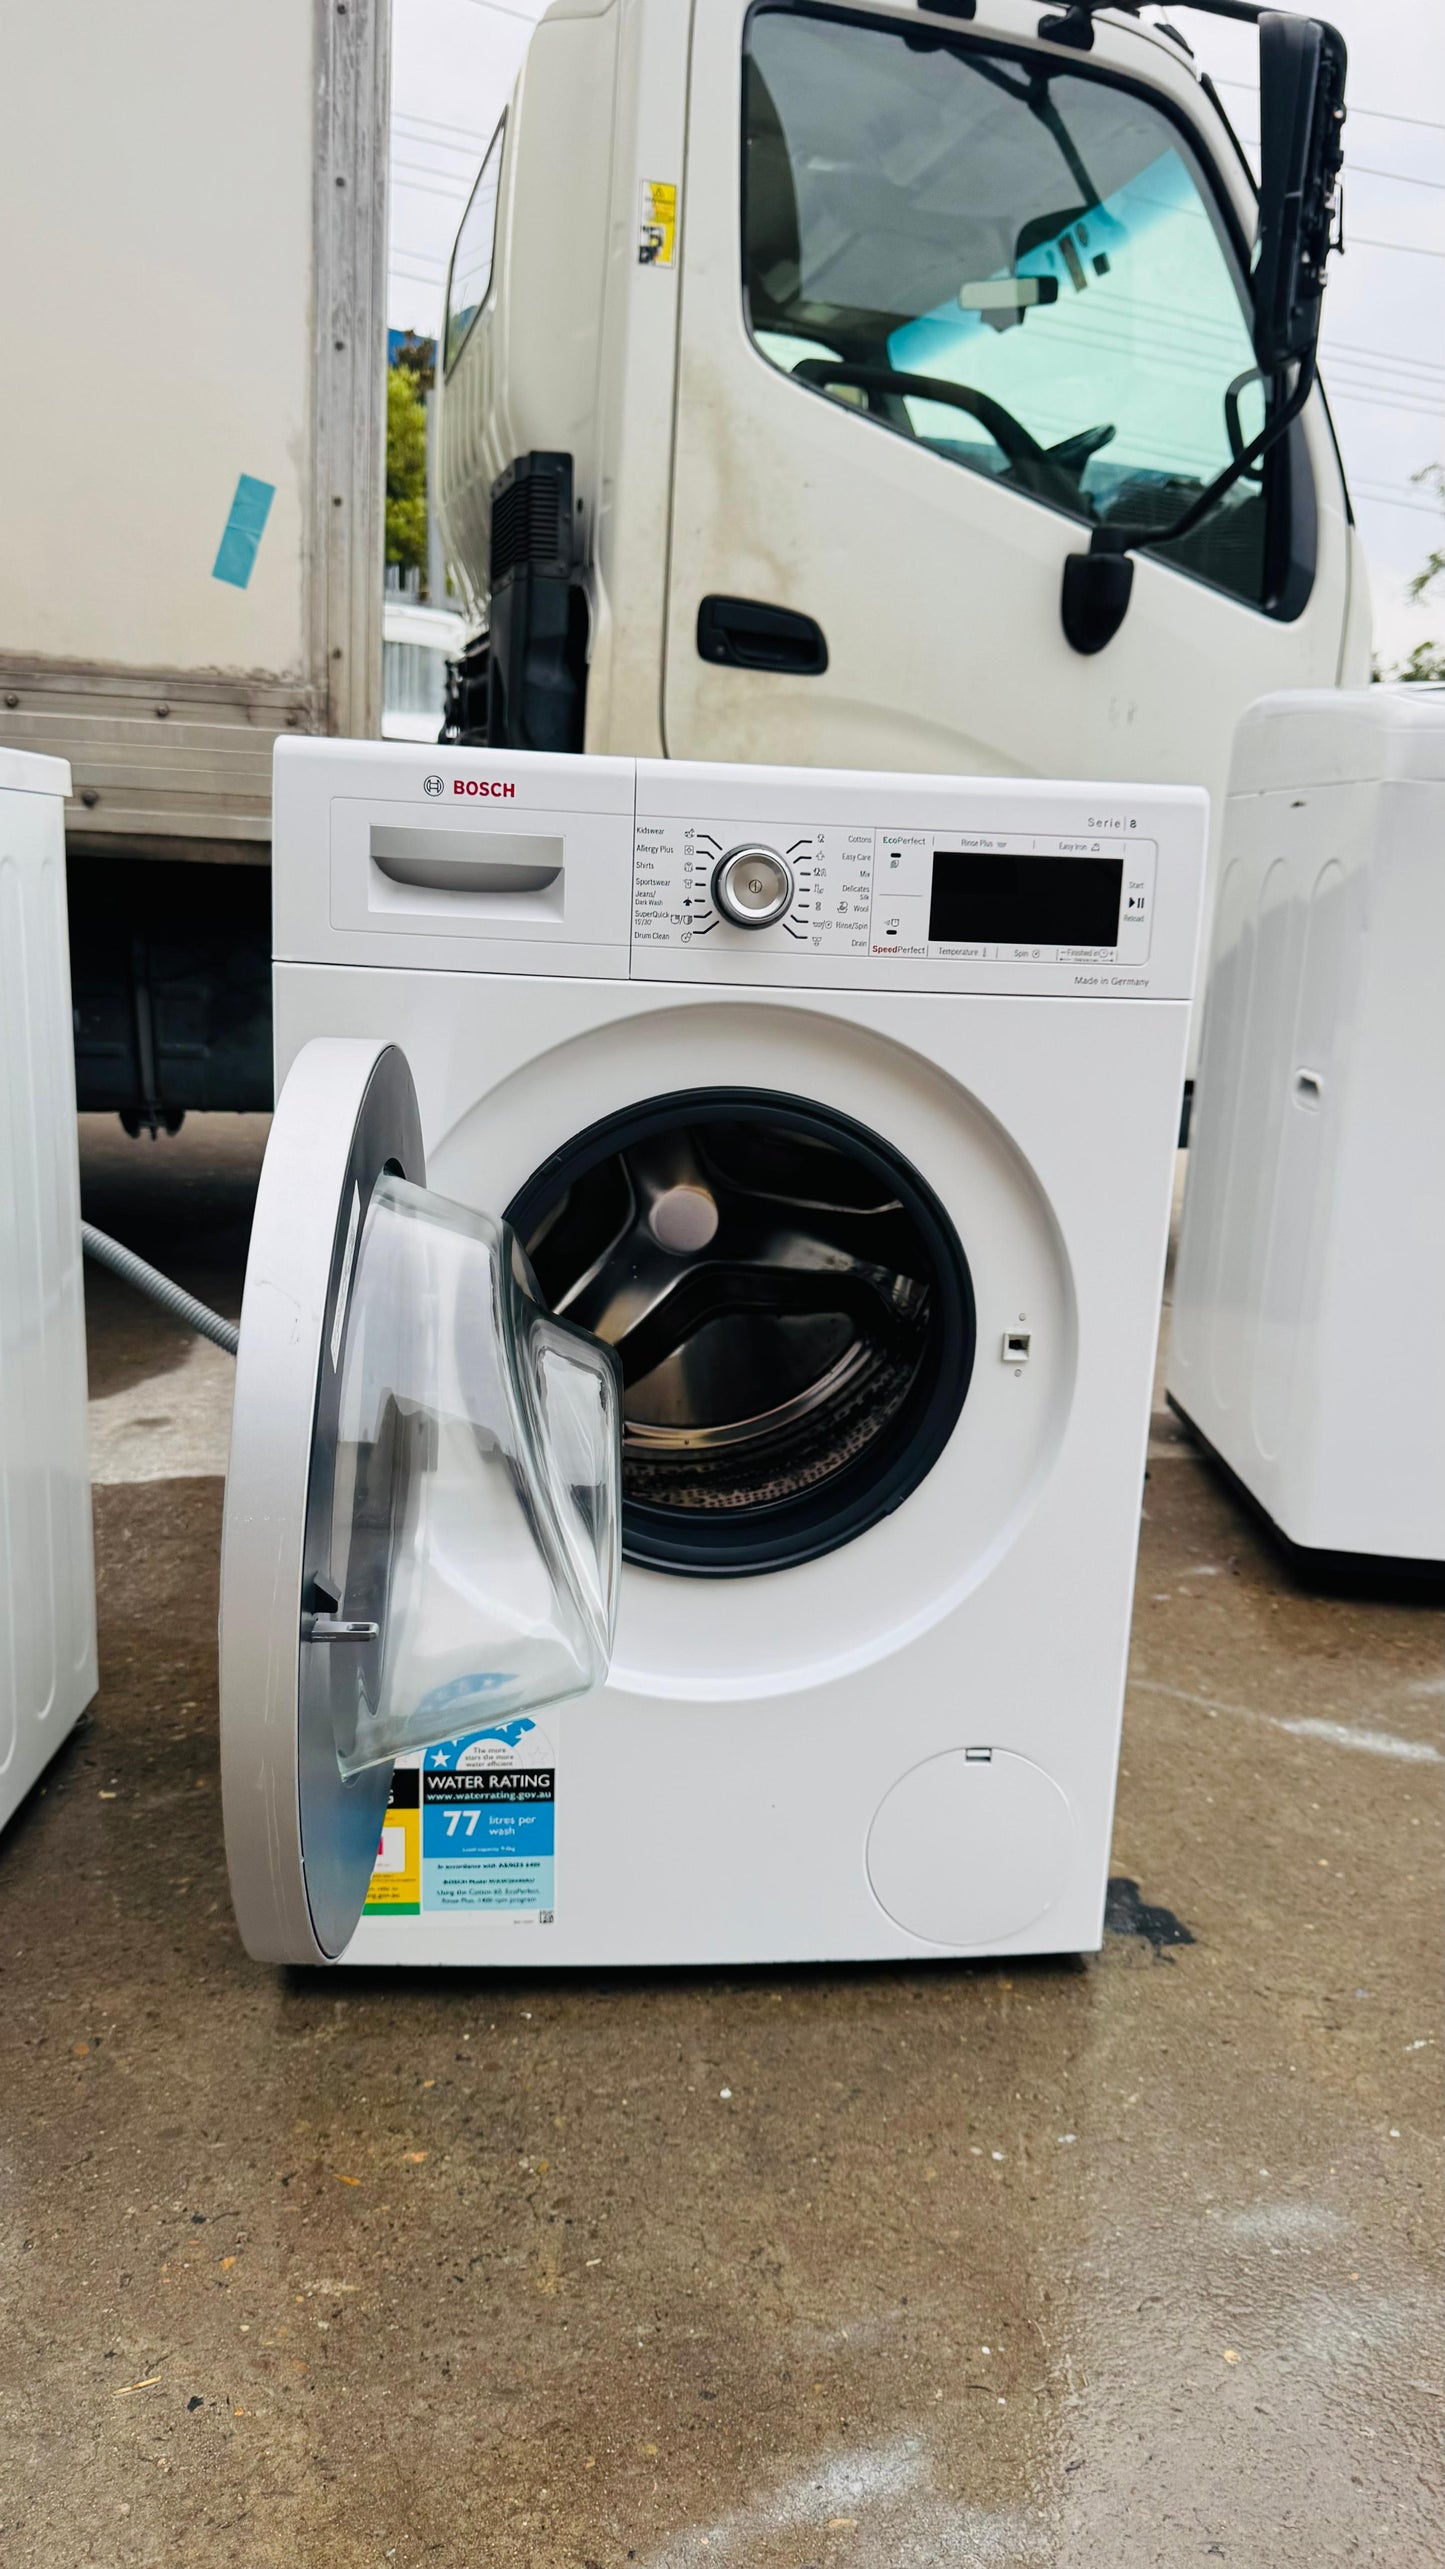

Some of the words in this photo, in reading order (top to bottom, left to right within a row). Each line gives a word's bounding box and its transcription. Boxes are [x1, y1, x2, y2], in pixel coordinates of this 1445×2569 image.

[453, 780, 515, 798] BOSCH
[1088, 817, 1121, 829] Serie
[1129, 819, 1138, 829] 8
[636, 826, 665, 835] Kidswear
[848, 835, 872, 844] Cottons
[882, 836, 926, 846] EcoPerfect
[979, 839, 994, 848] Plus
[636, 845, 659, 855] Allergy
[660, 845, 674, 854] Plus
[842, 852, 856, 862] Easy
[857, 853, 871, 861] Care
[635, 861, 655, 870] Shirts
[860, 870, 871, 878] Mix
[635, 877, 671, 887] Sportswear
[842, 884, 870, 893] Delicates
[635, 890, 657, 899] Jeans/
[635, 899, 649, 907] Dark
[853, 904, 869, 913] Wool
[635, 910, 670, 920] SuperQuick
[836, 920, 869, 930] Rinse/Spin
[634, 931, 652, 940] Drum
[652, 931, 671, 940] Clean
[851, 939, 868, 947] Drain
[872, 945, 926, 955] SpeedPerfect
[938, 947, 979, 957] Temperature
[1013, 949, 1029, 959] Spin
[1074, 976, 1099, 986] Made
[1100, 977, 1109, 985] in
[1110, 977, 1150, 988] Germany
[427, 1775, 484, 1789] WATER
[488, 1774, 550, 1788] RATING
[427, 1791, 552, 1801] www.waterrating.gov.au
[443, 1809, 482, 1837] 77
[489, 1816, 515, 1825] litres
[518, 1816, 536, 1826] per
[489, 1827, 516, 1836] wash
